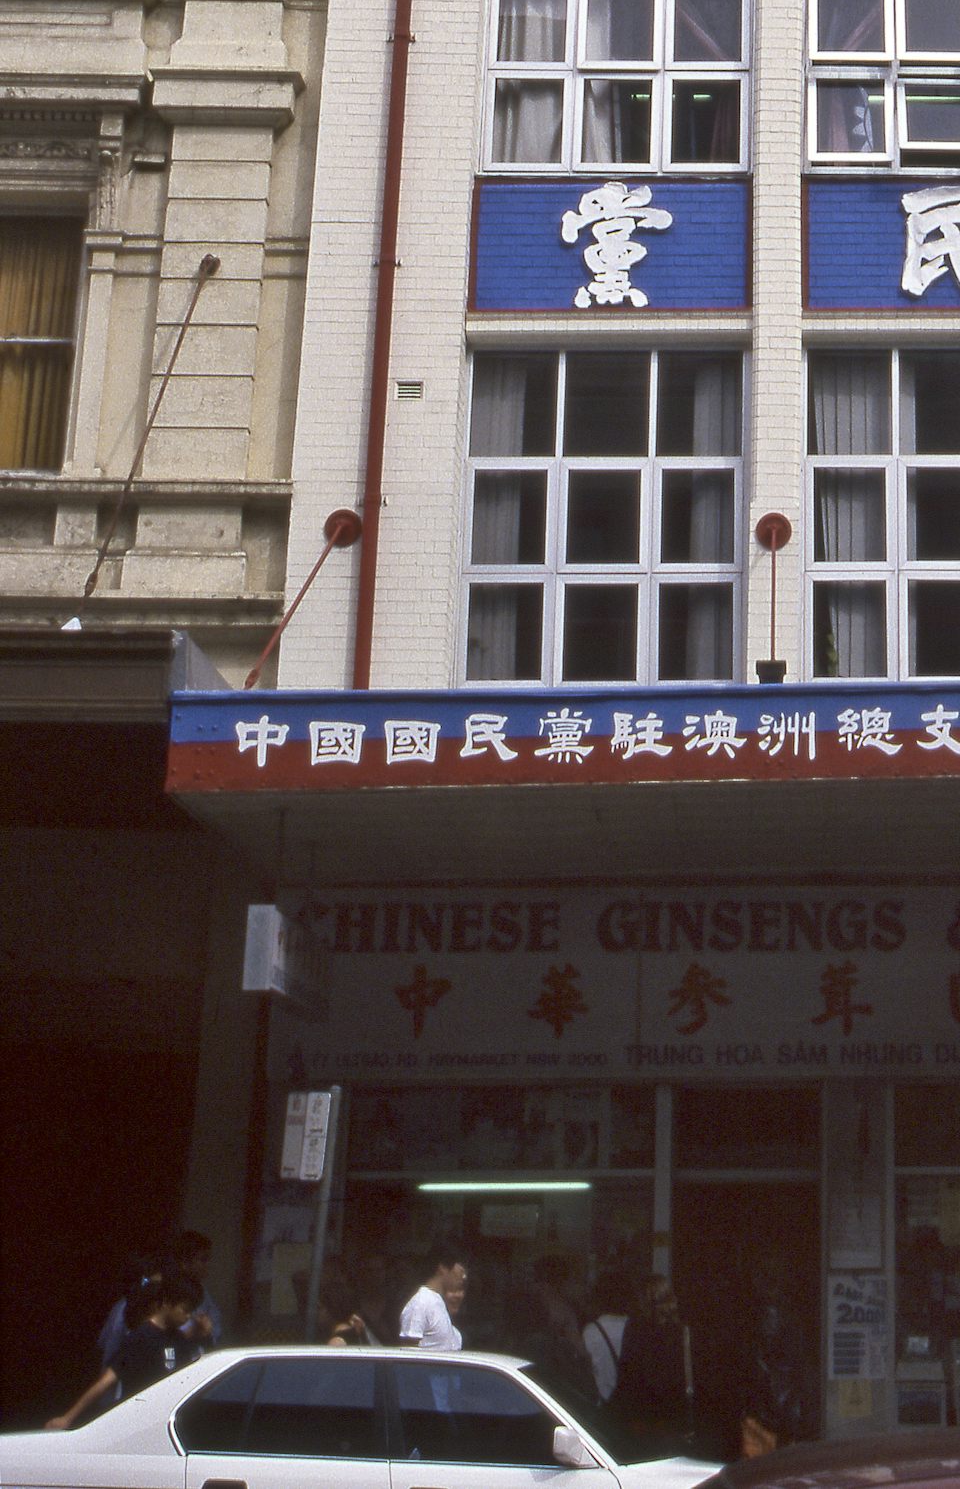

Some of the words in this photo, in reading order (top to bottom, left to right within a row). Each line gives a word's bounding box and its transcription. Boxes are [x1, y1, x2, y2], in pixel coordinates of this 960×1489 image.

[597, 899, 907, 953] GINSENGS
[625, 1044, 704, 1066] TRUNG
[715, 1044, 764, 1065] HOA
[839, 1042, 922, 1065] NHUNG
